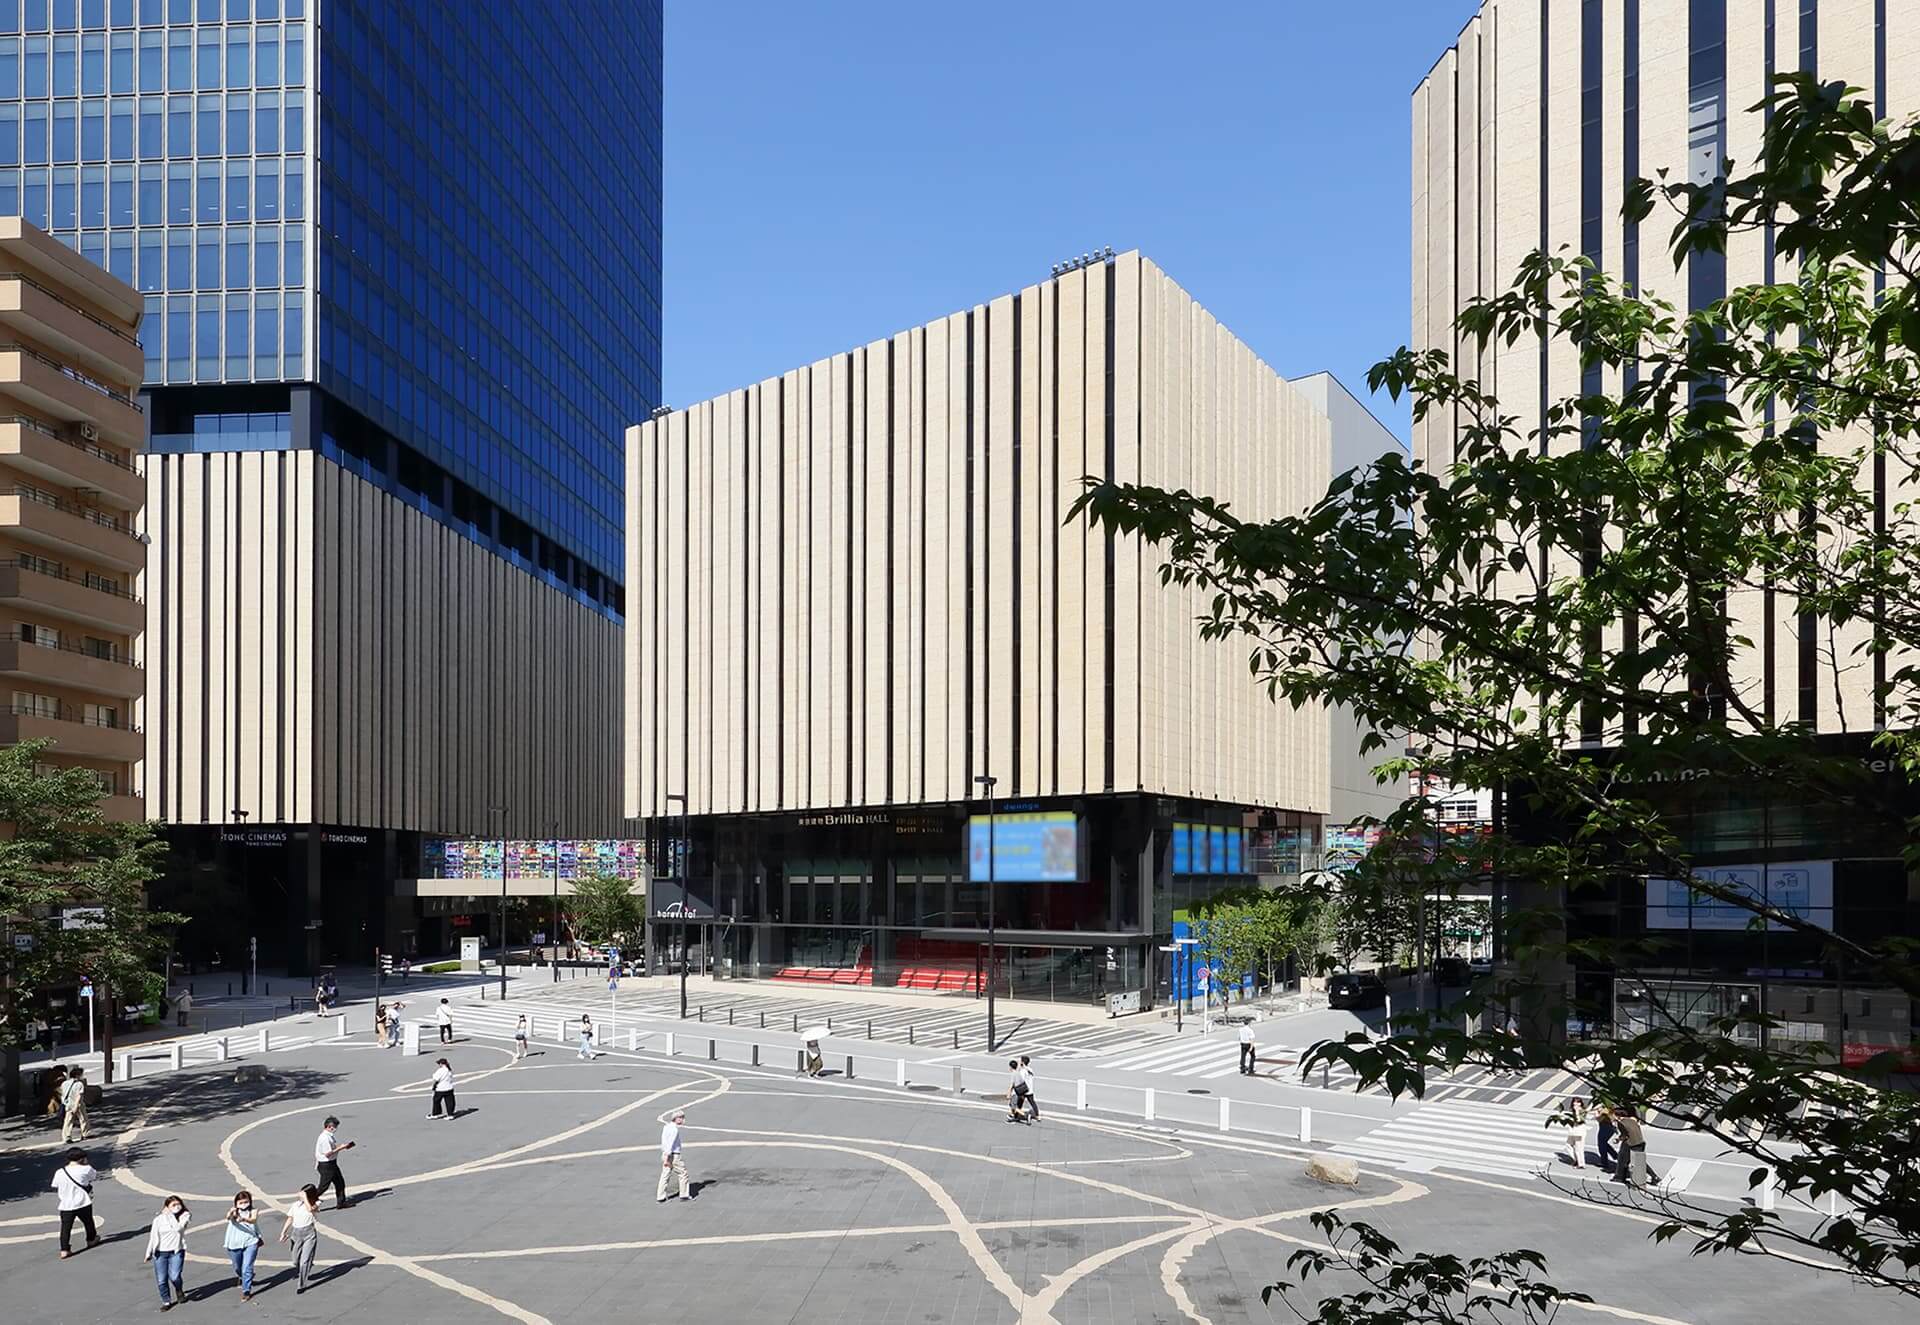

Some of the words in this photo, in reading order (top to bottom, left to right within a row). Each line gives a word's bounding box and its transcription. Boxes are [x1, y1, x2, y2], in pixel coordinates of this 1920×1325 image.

[825, 814, 864, 825] Brillia
[865, 814, 889, 824] HALL
[223, 833, 245, 841] TOHO
[247, 832, 287, 842] CINEMAS
[328, 834, 344, 843] TOHO
[344, 834, 368, 844] CINEMAS
